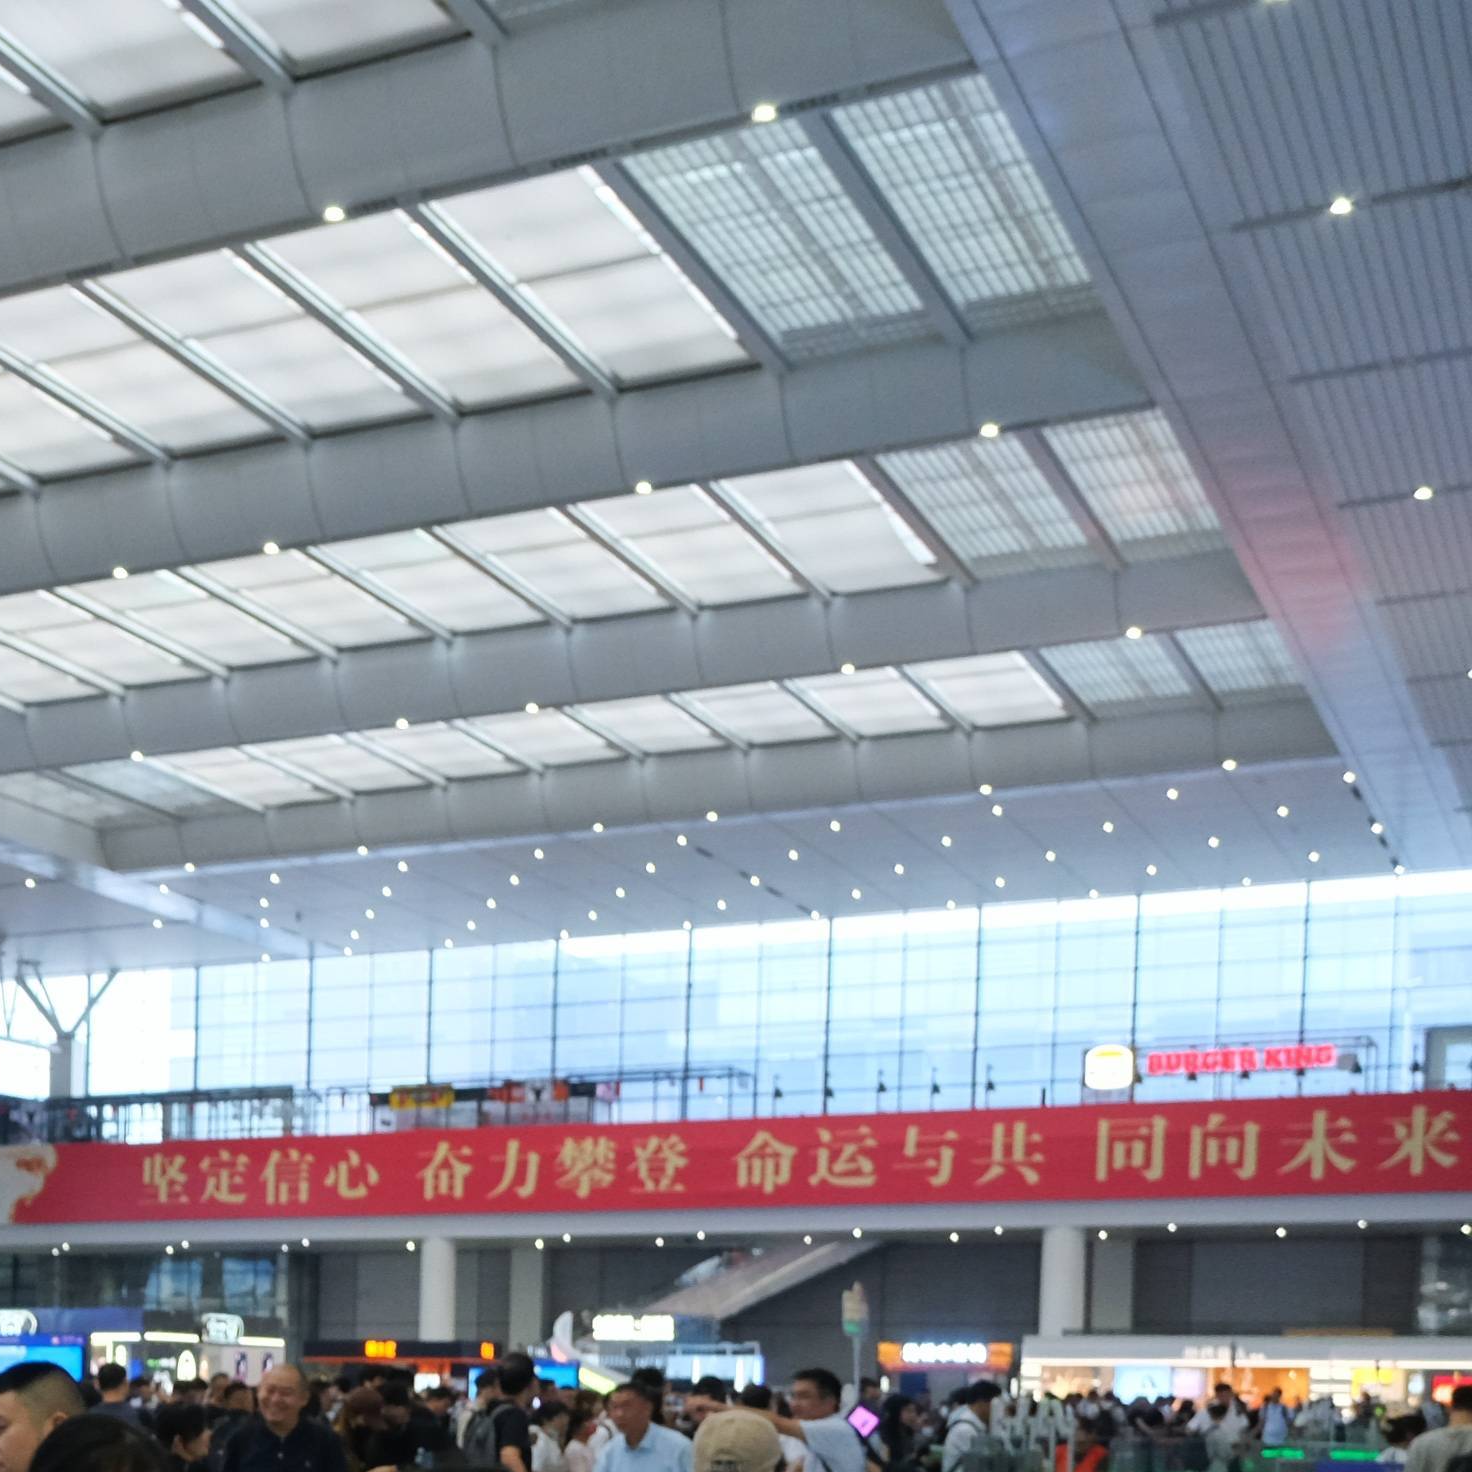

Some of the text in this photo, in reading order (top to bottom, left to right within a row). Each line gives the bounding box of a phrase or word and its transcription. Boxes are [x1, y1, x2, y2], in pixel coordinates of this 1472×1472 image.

[1147, 1044, 1337, 1076] BURGER KING
[141, 1105, 1461, 1205] 坚定信心 奋力攀登 命运与共 同向未来
